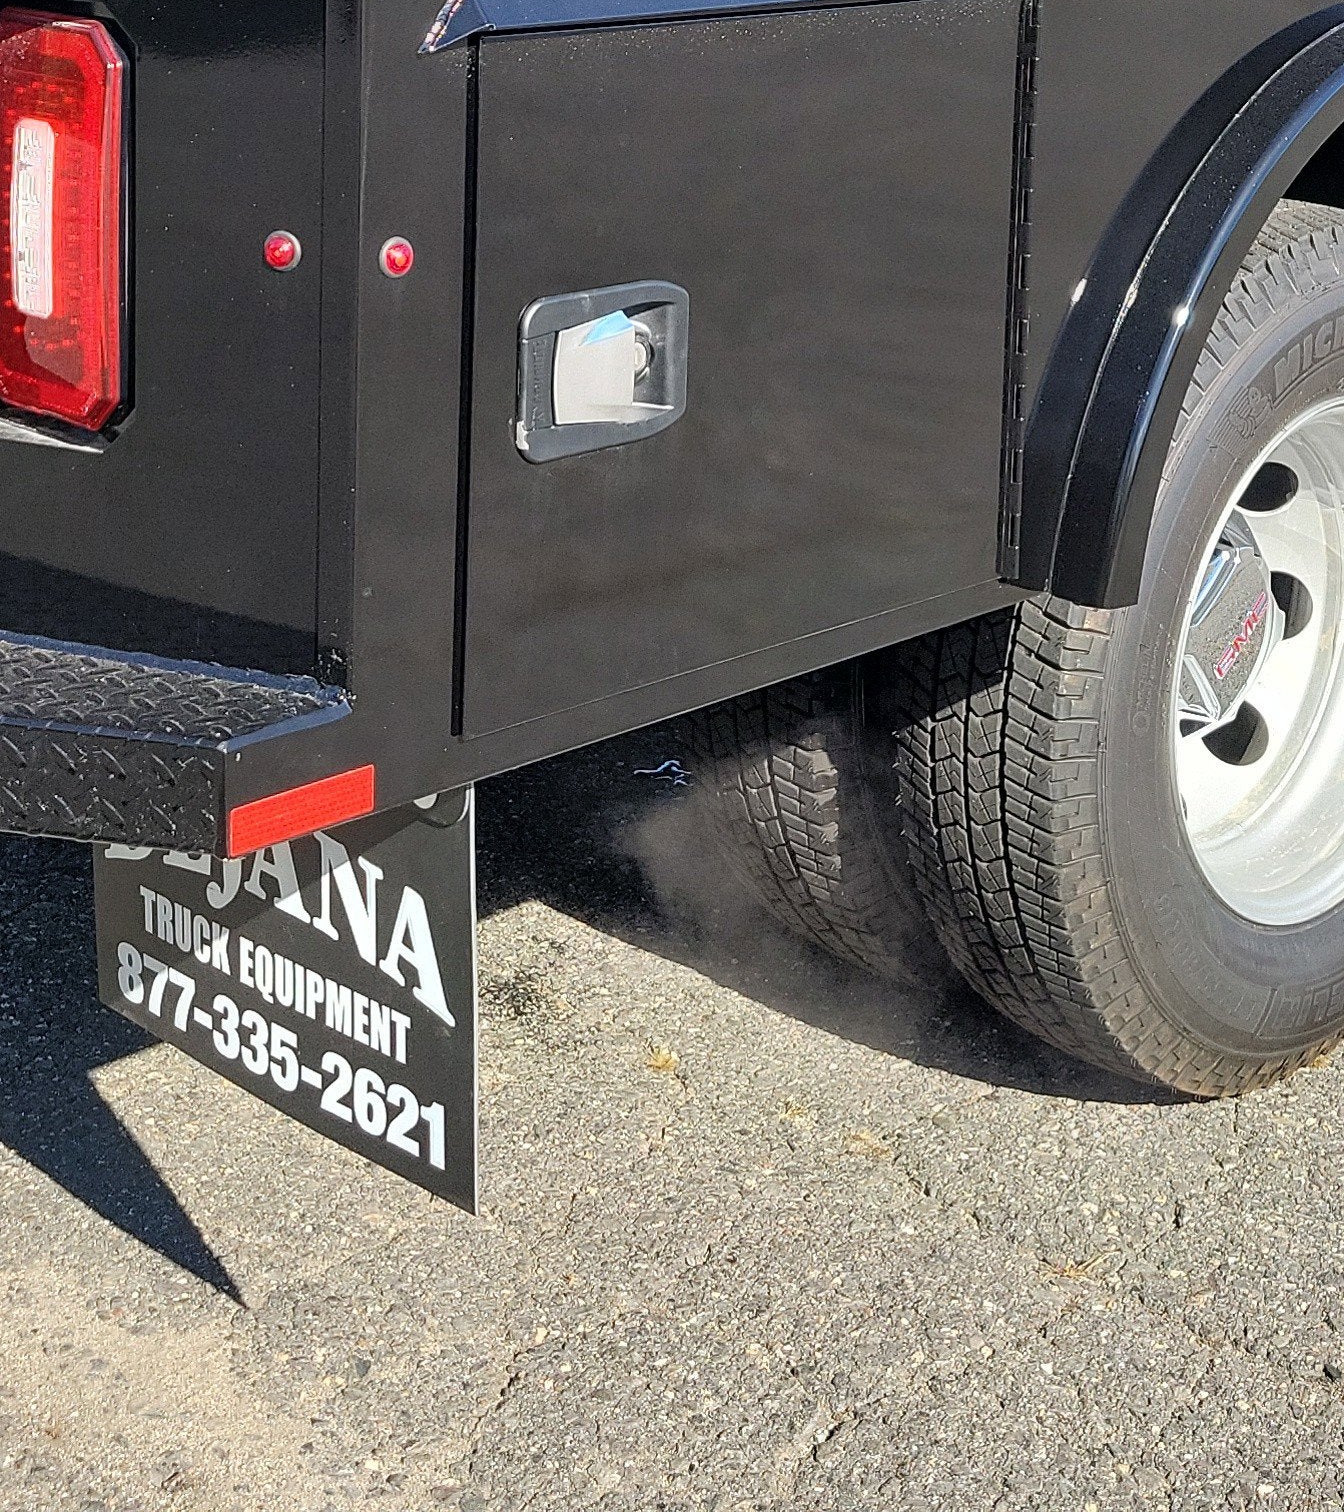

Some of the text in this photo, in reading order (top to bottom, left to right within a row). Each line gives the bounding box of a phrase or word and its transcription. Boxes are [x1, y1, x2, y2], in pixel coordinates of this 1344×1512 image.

[1212, 590, 1270, 679] GMC
[104, 831, 456, 1027] JANA
[139, 884, 412, 1065] TRUCK EQUIPMENT
[117, 941, 446, 1171] 877-335-2621
